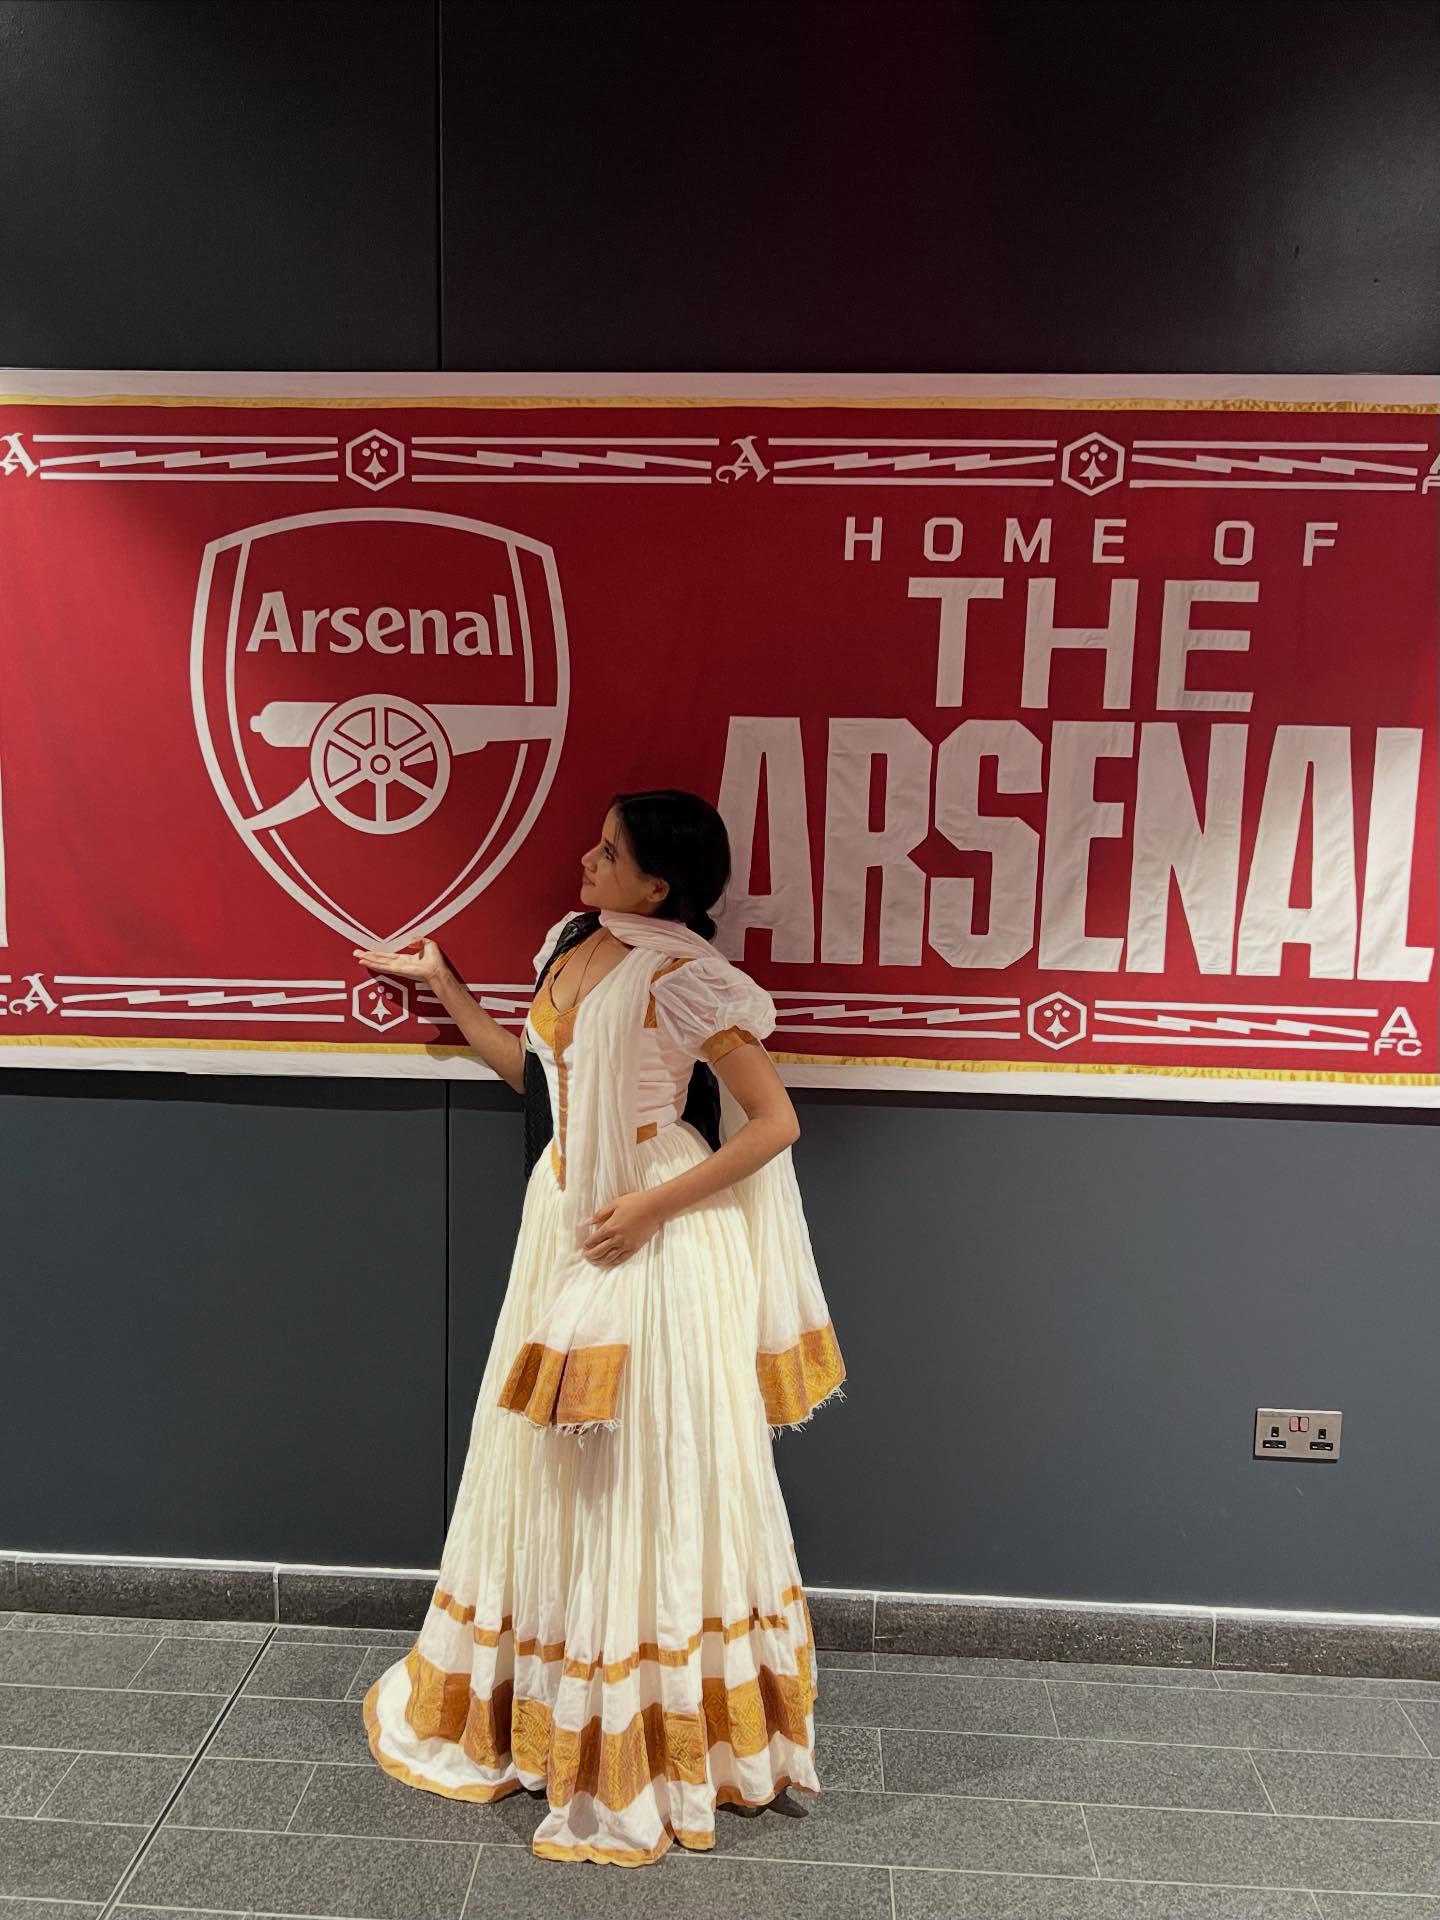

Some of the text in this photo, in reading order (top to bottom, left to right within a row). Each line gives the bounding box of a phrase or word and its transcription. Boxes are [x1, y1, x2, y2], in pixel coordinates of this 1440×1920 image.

[844, 516, 1339, 566] HOME OF
[245, 590, 513, 656] Arsenal
[908, 577, 1260, 712] THE
[709, 716, 1434, 983] ARSENAL
